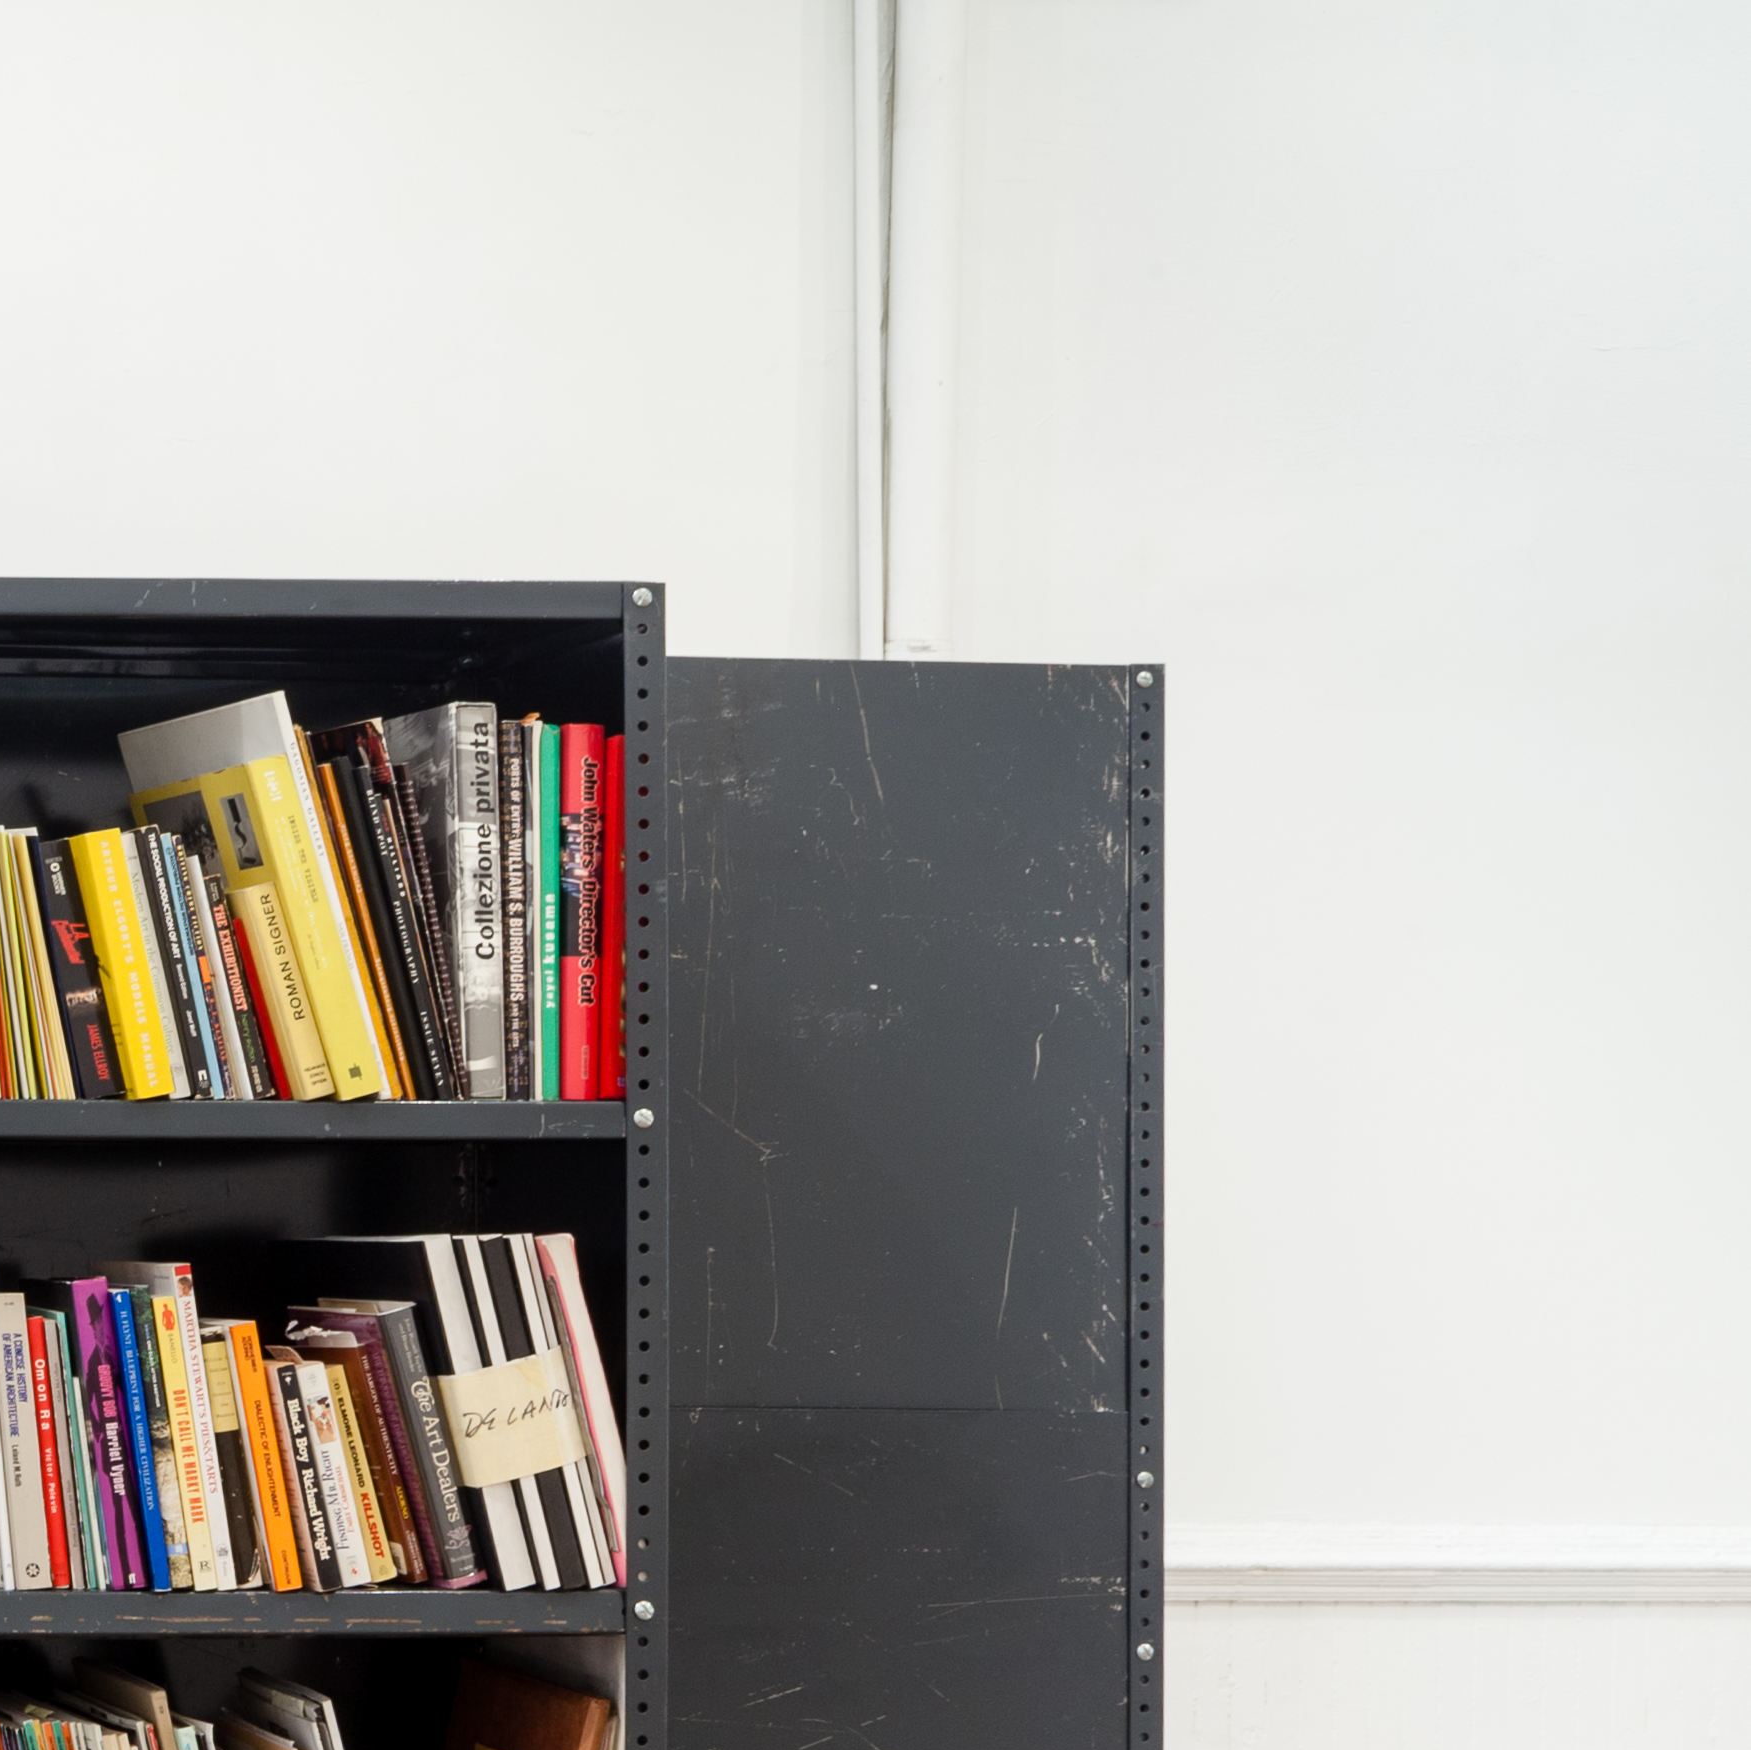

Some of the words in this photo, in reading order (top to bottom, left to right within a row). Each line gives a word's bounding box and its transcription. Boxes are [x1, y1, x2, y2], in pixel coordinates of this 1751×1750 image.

[582, 758, 598, 804] John
[581, 806, 598, 869] Waters
[259, 894, 286, 956] SIGNER
[580, 879, 597, 970] Director's
[100, 841, 118, 893] ARTHUR
[112, 901, 136, 964] ELGORT'S
[128, 972, 147, 1024] MODELS
[139, 1031, 159, 1088] MANUAL
[278, 958, 306, 1020] ROMAN
[579, 974, 595, 1004] Cut
[173, 1390, 190, 1418] DON'T
[410, 1375, 436, 1412] The
[177, 1421, 193, 1442] CALL
[286, 1397, 302, 1434] Black
[421, 1416, 443, 1447] Art
[181, 1445, 195, 1458] ME
[292, 1438, 311, 1463] Boy
[184, 1462, 200, 1494] MARKY
[302, 1468, 323, 1517] Richard
[337, 1397, 355, 1438] ELMORE
[348, 1441, 365, 1487] LEONARD
[360, 1493, 384, 1558] KILLSHOT
[430, 1449, 461, 1522] Dealers
[188, 1498, 204, 1524] MARK
[311, 1518, 330, 1560] Wright
